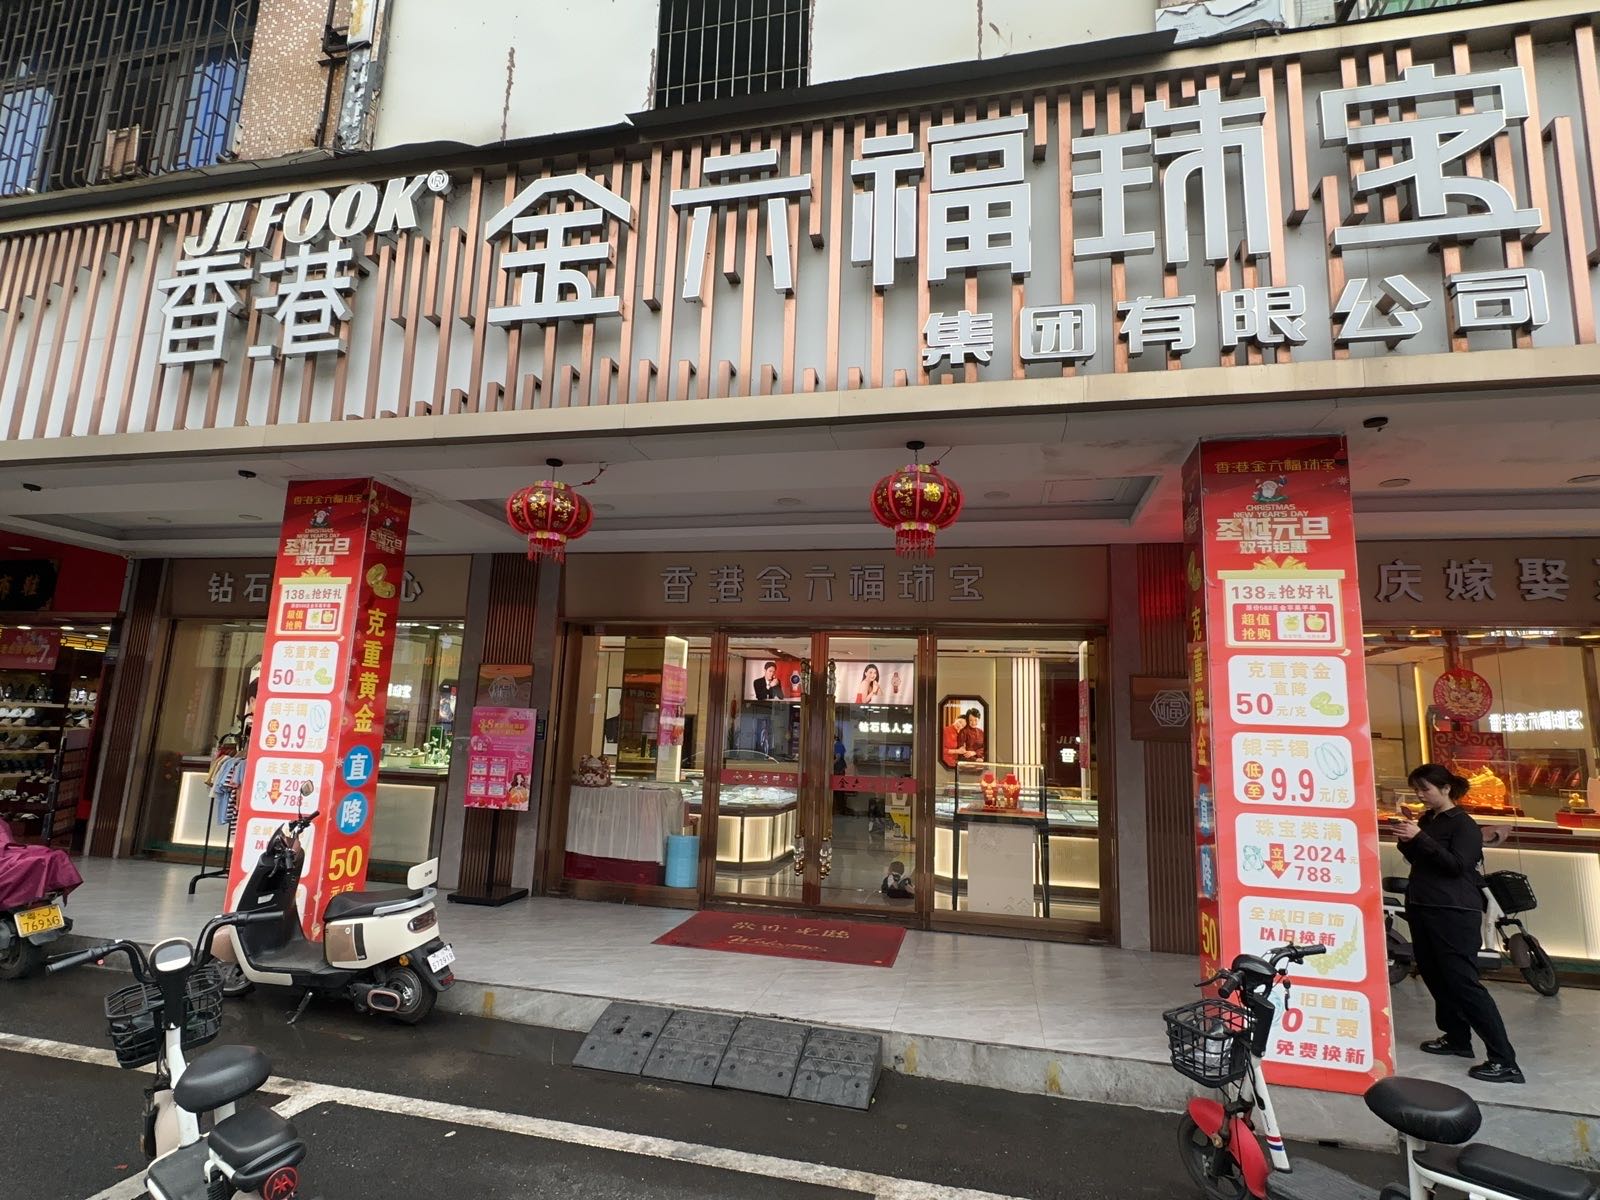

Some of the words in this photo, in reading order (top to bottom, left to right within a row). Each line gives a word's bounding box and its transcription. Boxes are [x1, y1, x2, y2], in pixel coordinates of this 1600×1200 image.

[922, 267, 1550, 367] 集团有限公司
[1216, 516, 1331, 541] 圣诞元旦
[283, 537, 350, 556] 圣诞元旦
[660, 563, 985, 604] 香港金六福珠宝
[1377, 557, 1600, 602] 庆嫁娶
[1231, 584, 1333, 600] 138元抢好礼
[1241, 613, 1271, 626] 超值
[1241, 627, 1271, 641] 抢购
[354, 608, 388, 733] 克重黄金
[1247, 661, 1332, 680] 克重黄金
[1273, 681, 1308, 696] 直降
[1242, 737, 1310, 759] 银手镯
[340, 753, 369, 829] 直降
[1255, 818, 1343, 842] 珠宝类满
[328, 845, 362, 881] 50
[1202, 912, 1218, 961] 50
[1259, 927, 1336, 947] 以旧换新
[1276, 1039, 1366, 1065] 免费换新
